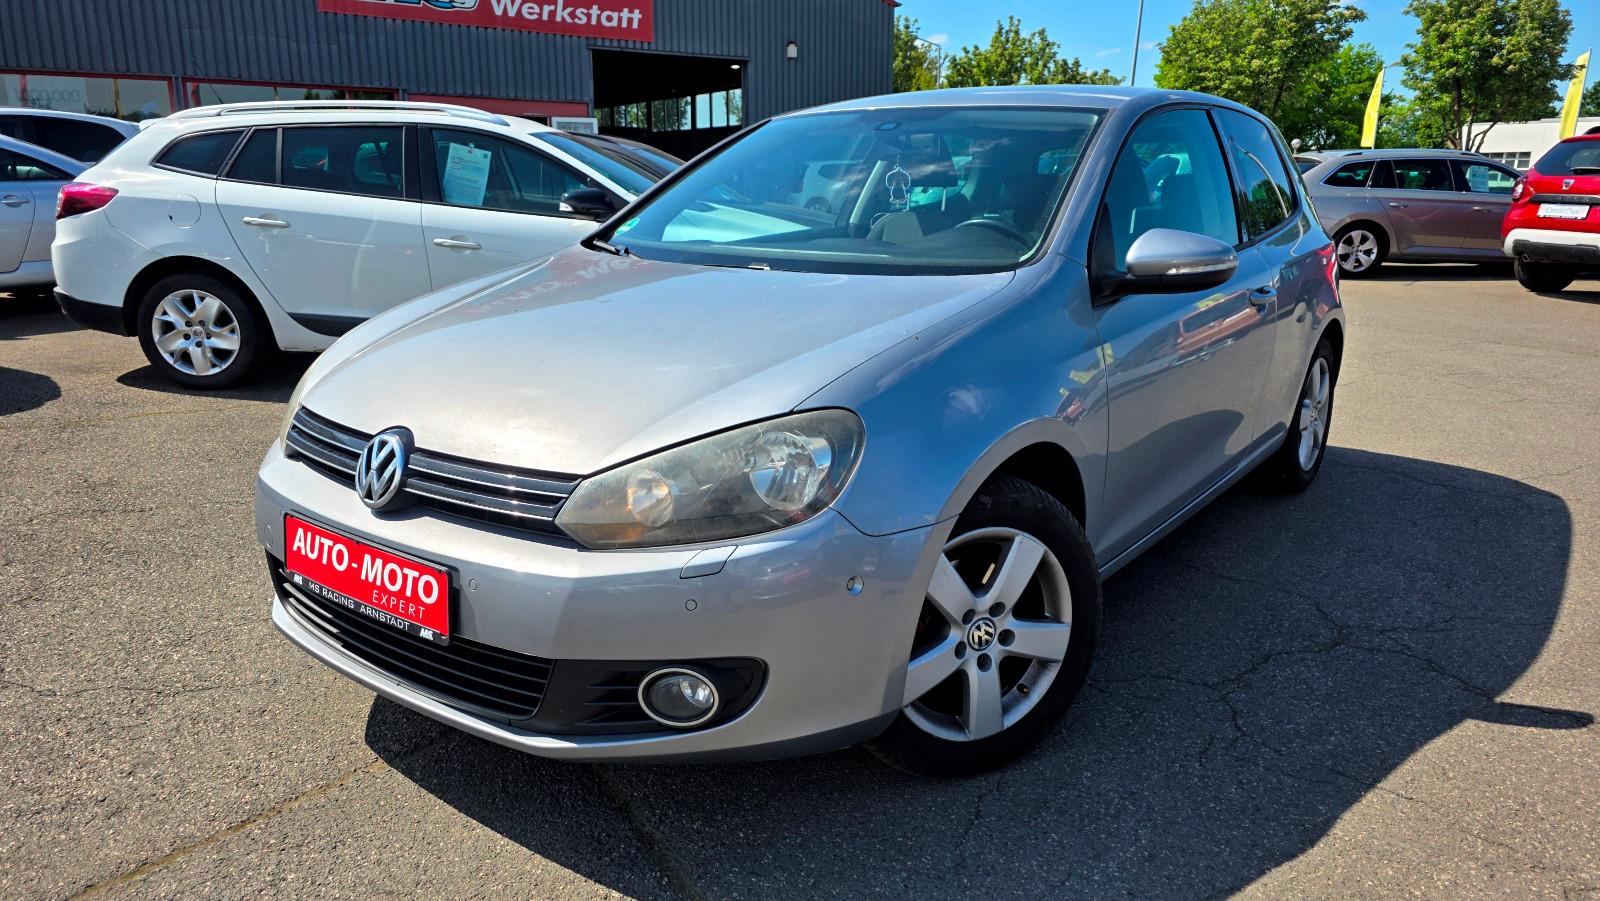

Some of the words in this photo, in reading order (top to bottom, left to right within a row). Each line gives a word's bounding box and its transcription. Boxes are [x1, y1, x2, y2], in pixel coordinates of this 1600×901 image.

[490, 0, 642, 29] Werkstatt
[308, 581, 320, 594] MS
[322, 587, 355, 609] RACING
[359, 604, 410, 631] ARNSTADT
[372, 590, 426, 620] EXPERT
